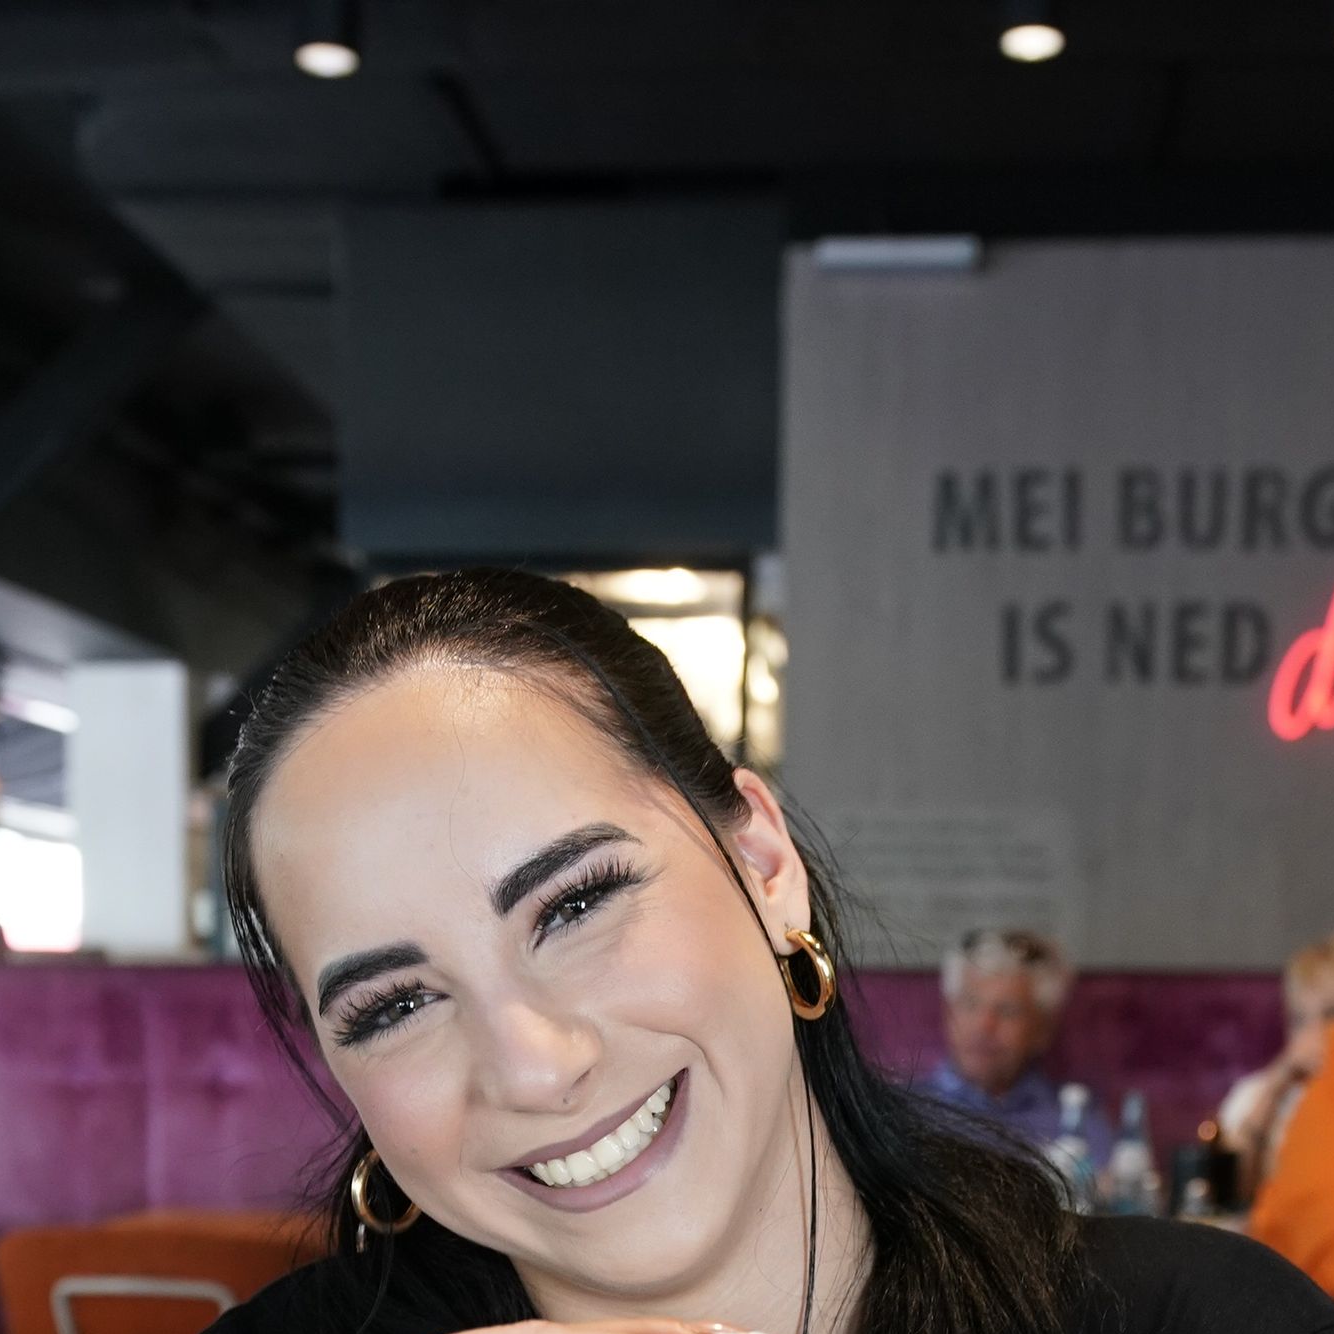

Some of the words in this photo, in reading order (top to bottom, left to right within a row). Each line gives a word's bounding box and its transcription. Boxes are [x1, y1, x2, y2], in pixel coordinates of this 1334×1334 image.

[933, 466, 1080, 552] MEI
[1001, 600, 1072, 685] IS
[1105, 600, 1270, 685] NED
